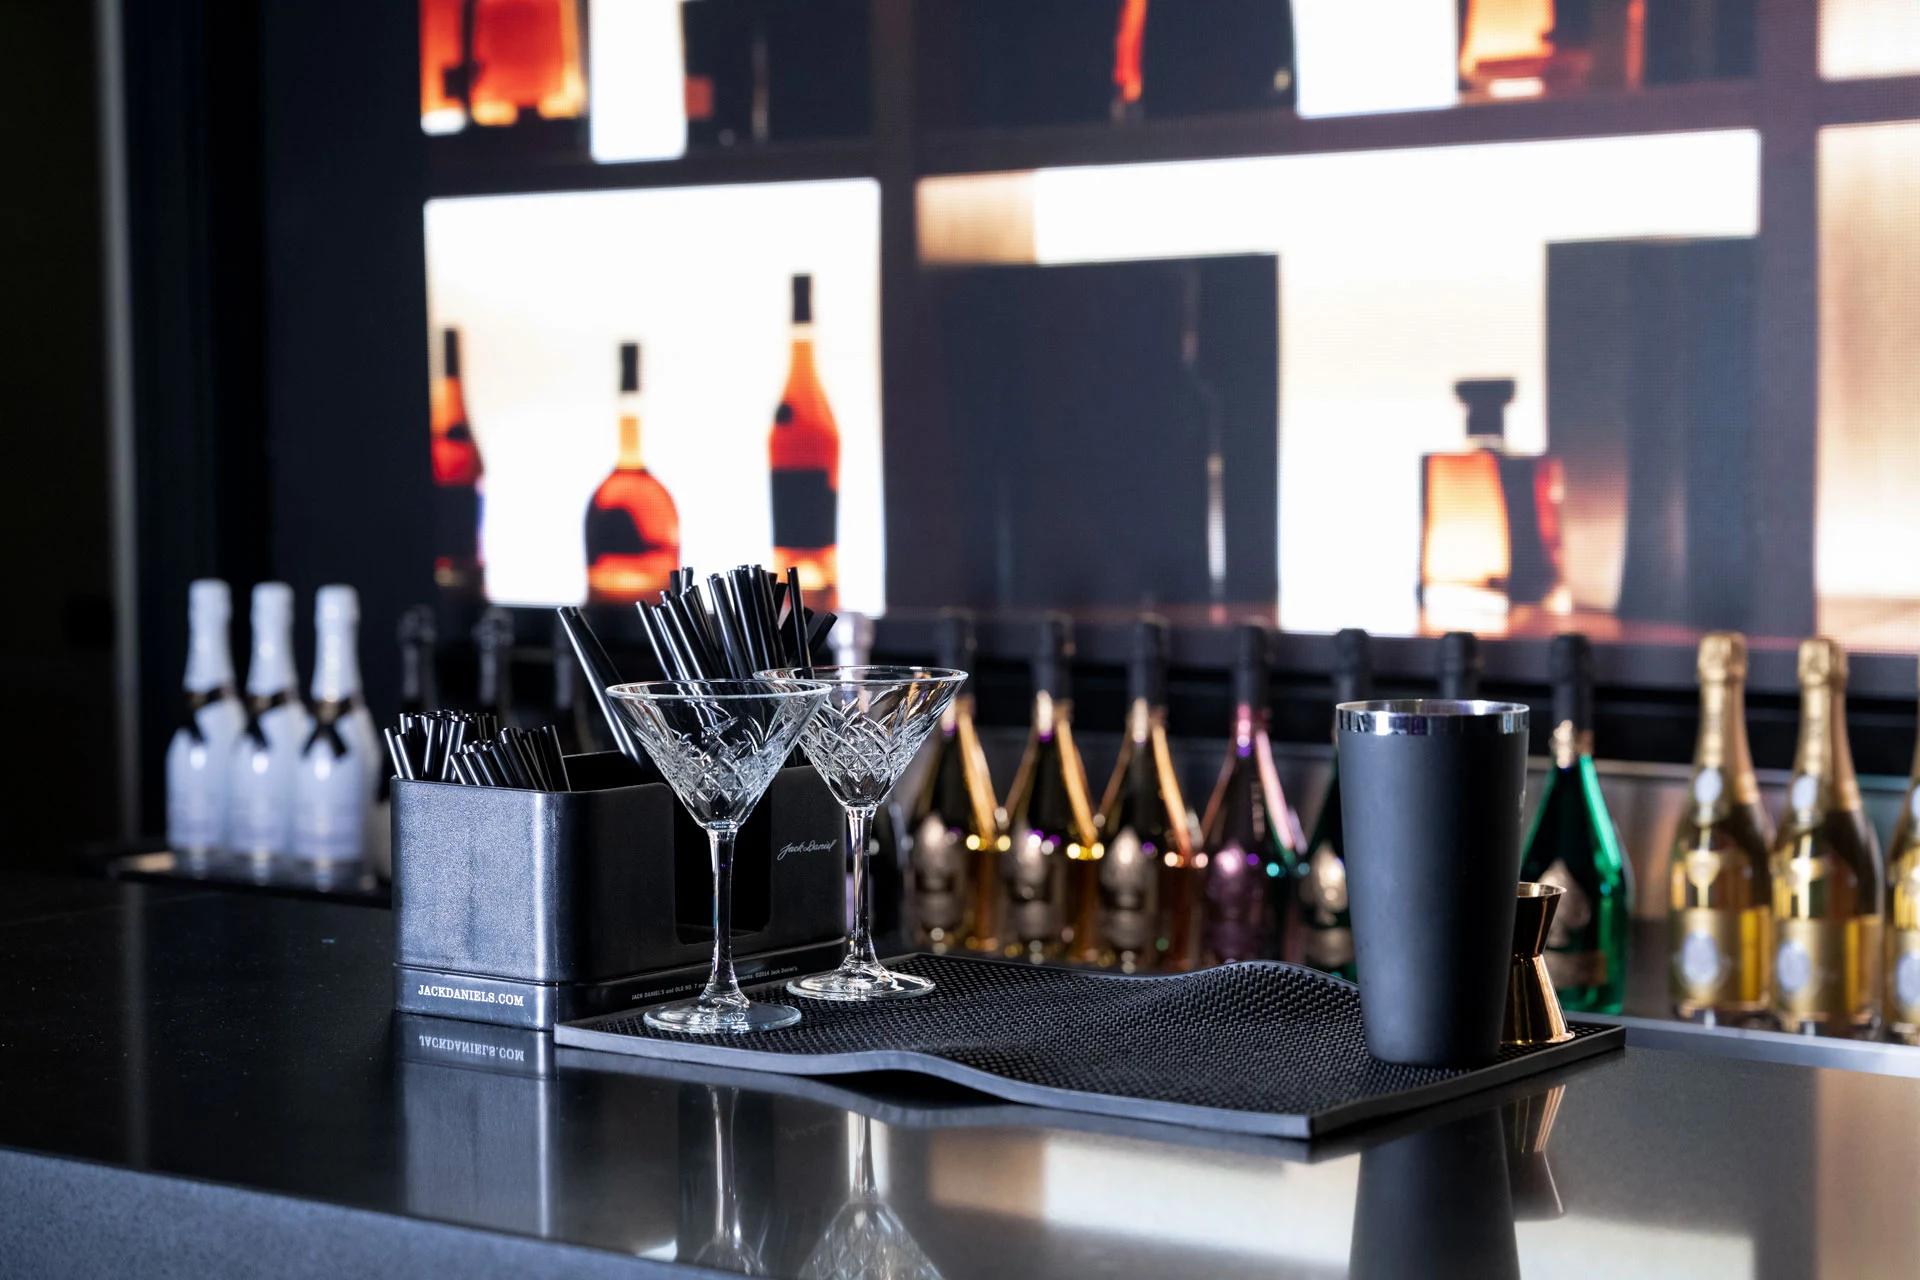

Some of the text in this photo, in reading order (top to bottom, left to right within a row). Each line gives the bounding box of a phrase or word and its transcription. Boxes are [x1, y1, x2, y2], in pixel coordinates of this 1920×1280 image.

[776, 838, 838, 861] Jack Daniel
[418, 984, 524, 1006] JACKDANIELS.COM
